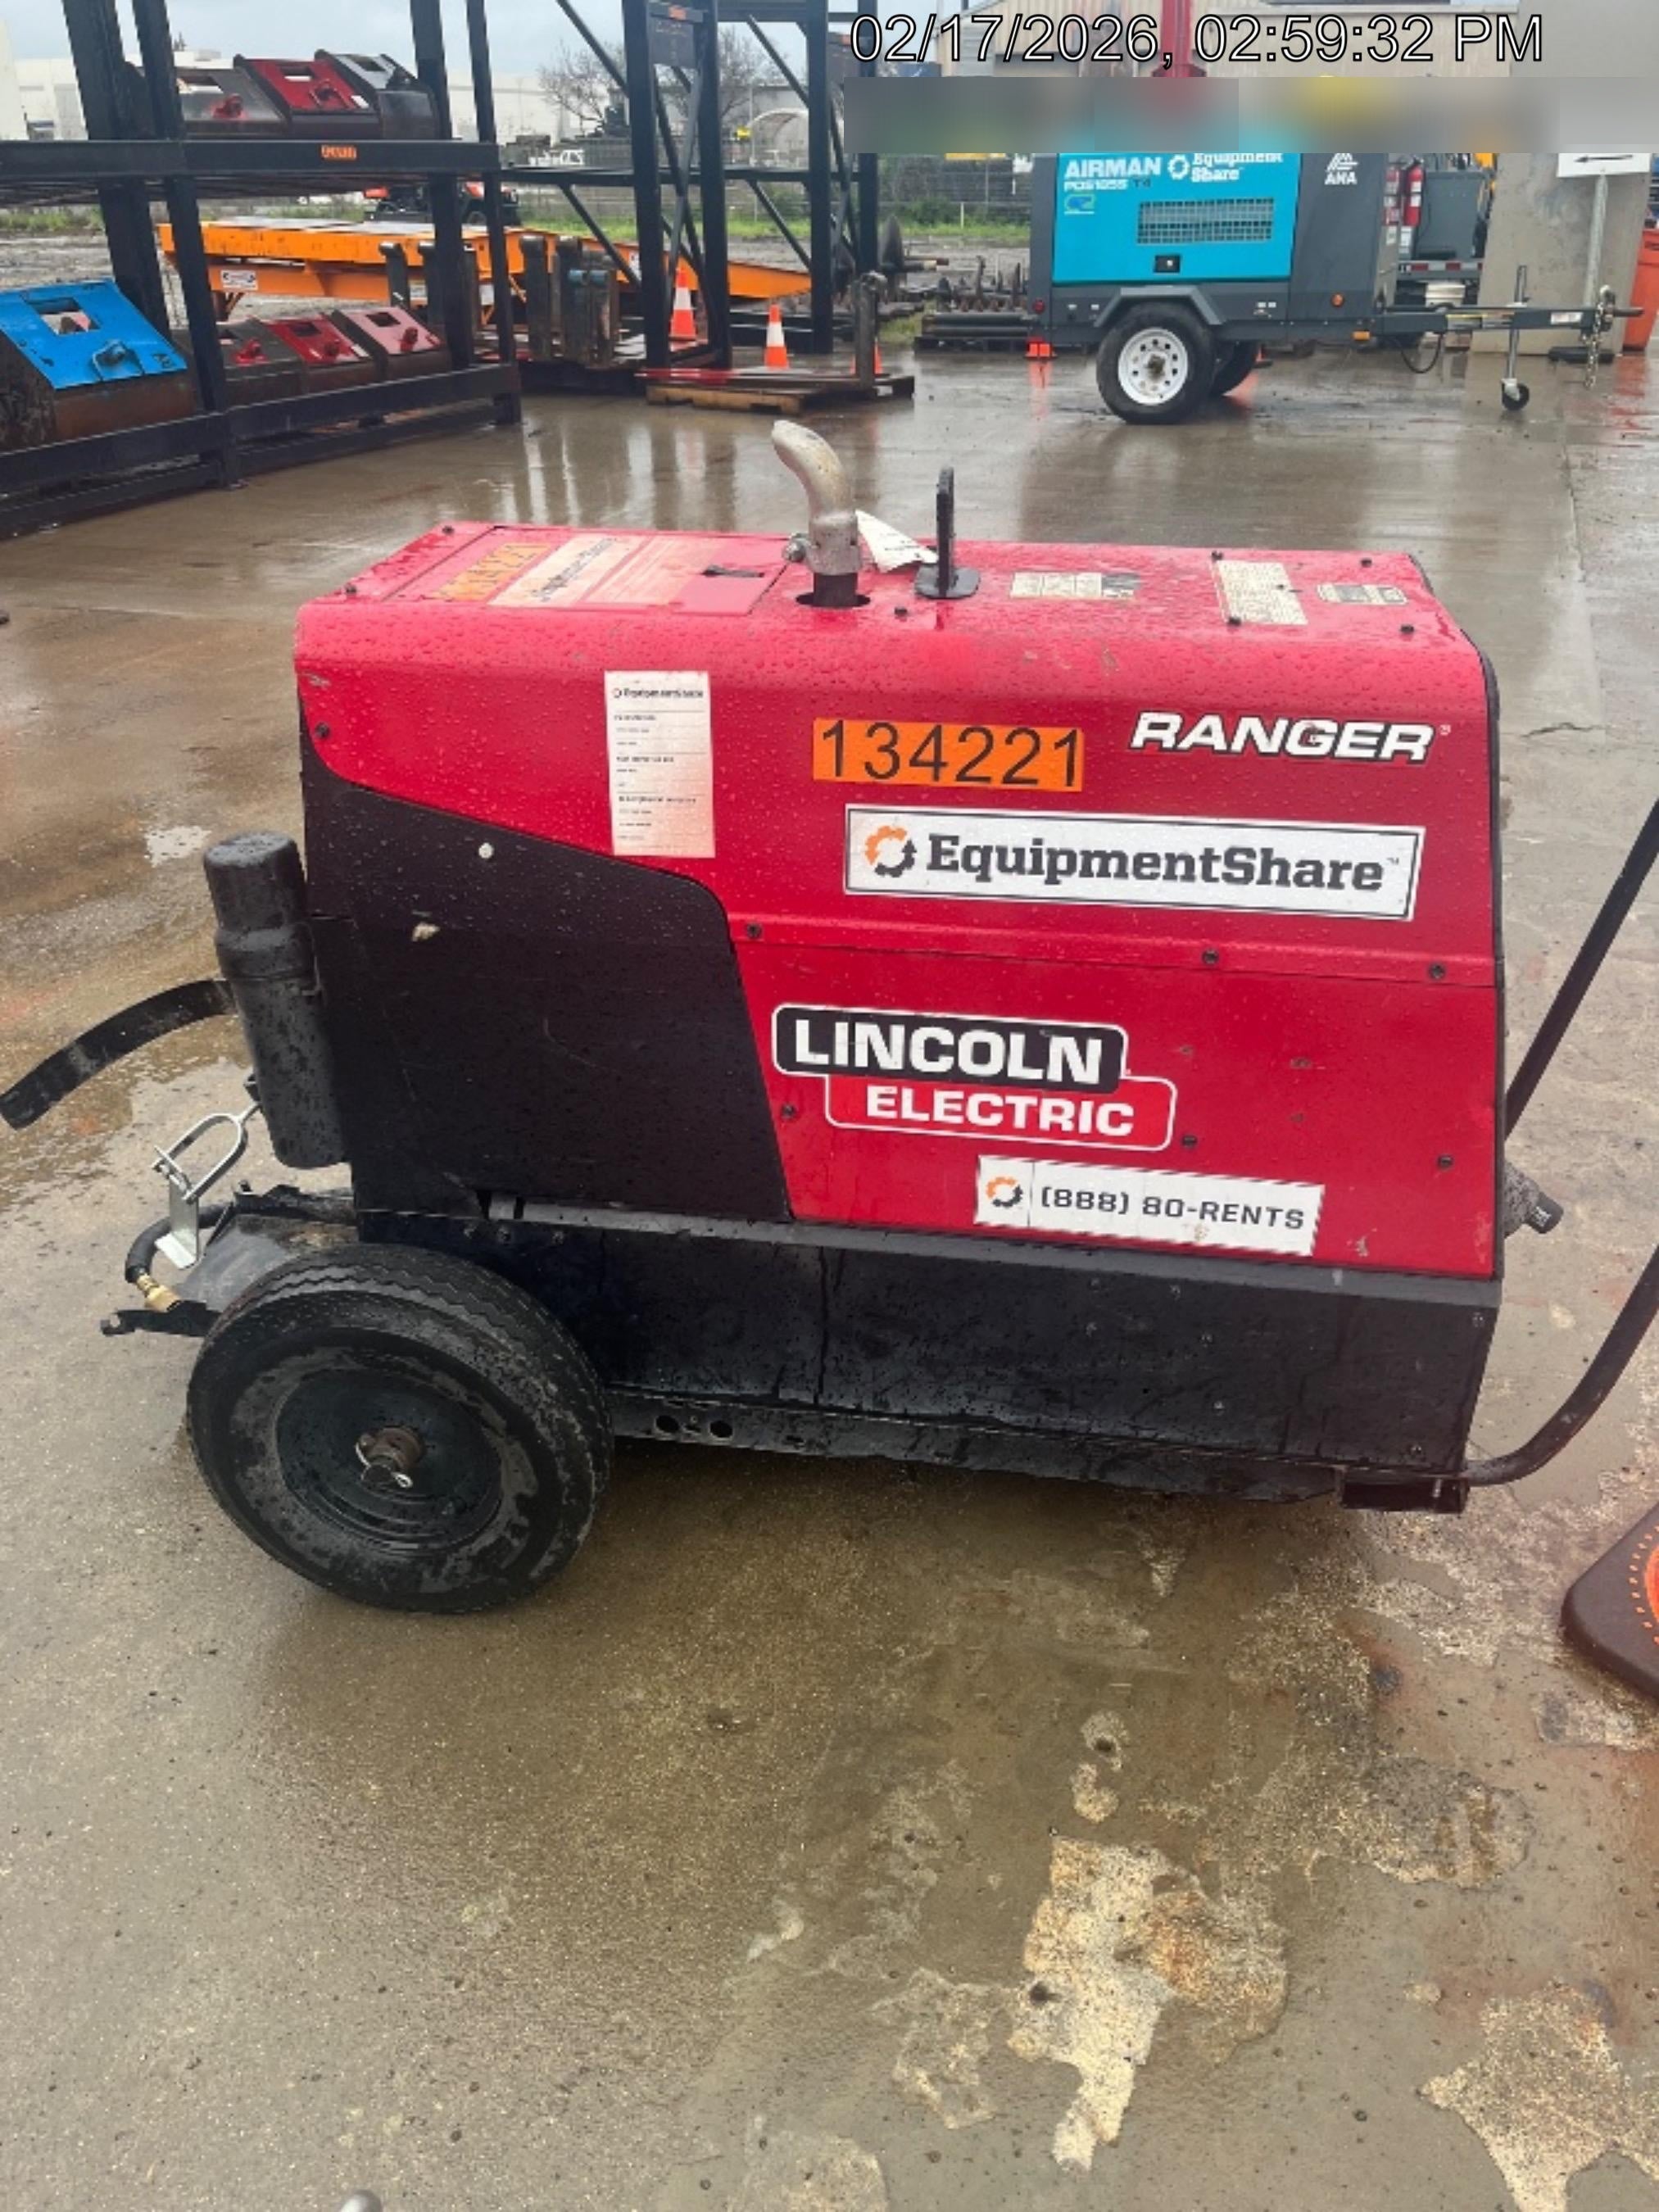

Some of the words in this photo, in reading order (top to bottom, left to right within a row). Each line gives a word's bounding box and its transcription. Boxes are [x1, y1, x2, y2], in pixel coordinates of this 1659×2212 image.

[1064, 156, 1162, 179] AIRMAN
[1190, 166, 1240, 183] Share
[821, 719, 1079, 788] 134221
[1130, 711, 1435, 762] RANGER
[927, 833, 1384, 891] EquipmentShare
[795, 1018, 1103, 1086] LINCOLN
[866, 1086, 1135, 1137] ELECTRIC
[1040, 1185, 1130, 1214] (888)
[1141, 1196, 1304, 1231] 80-RENTS
